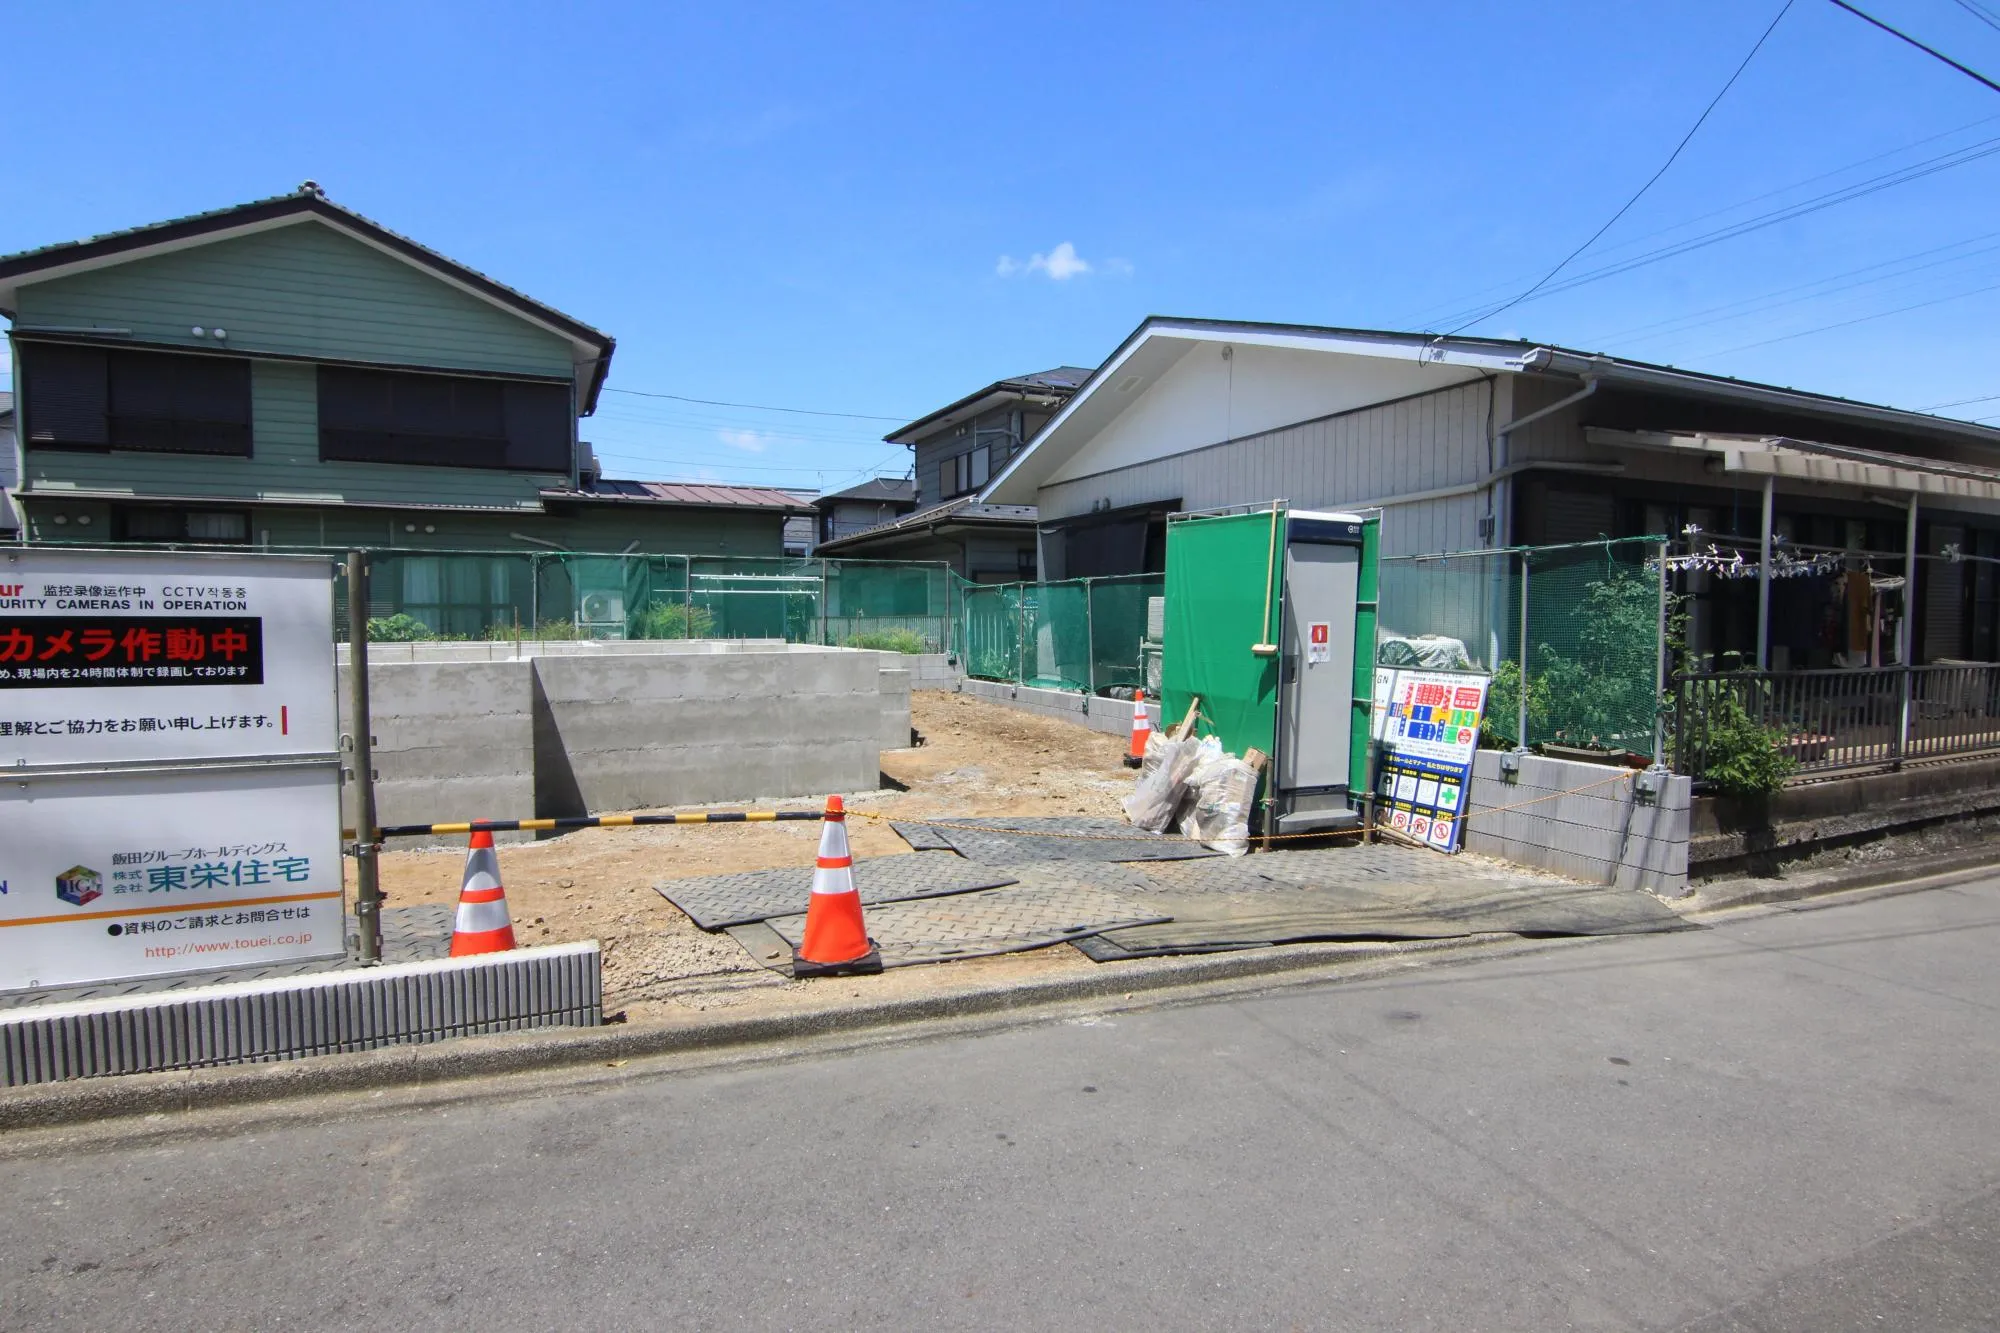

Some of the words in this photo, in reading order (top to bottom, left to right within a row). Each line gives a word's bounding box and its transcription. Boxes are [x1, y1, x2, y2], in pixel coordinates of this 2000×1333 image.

[43, 584, 146, 598] 监控录像运作中
[56, 599, 131, 610] CAMERAS
[139, 600, 154, 610] IN
[163, 600, 247, 611] OPERATION
[0, 627, 248, 662] カメラ作動中
[0, 714, 273, 736] 理解とご協力をお願い申し上げます。
[112, 842, 288, 866] 飯田グループホールディングス
[147, 856, 310, 893] 東栄住宅
[145, 932, 312, 958] http://www.touei.co.jp
